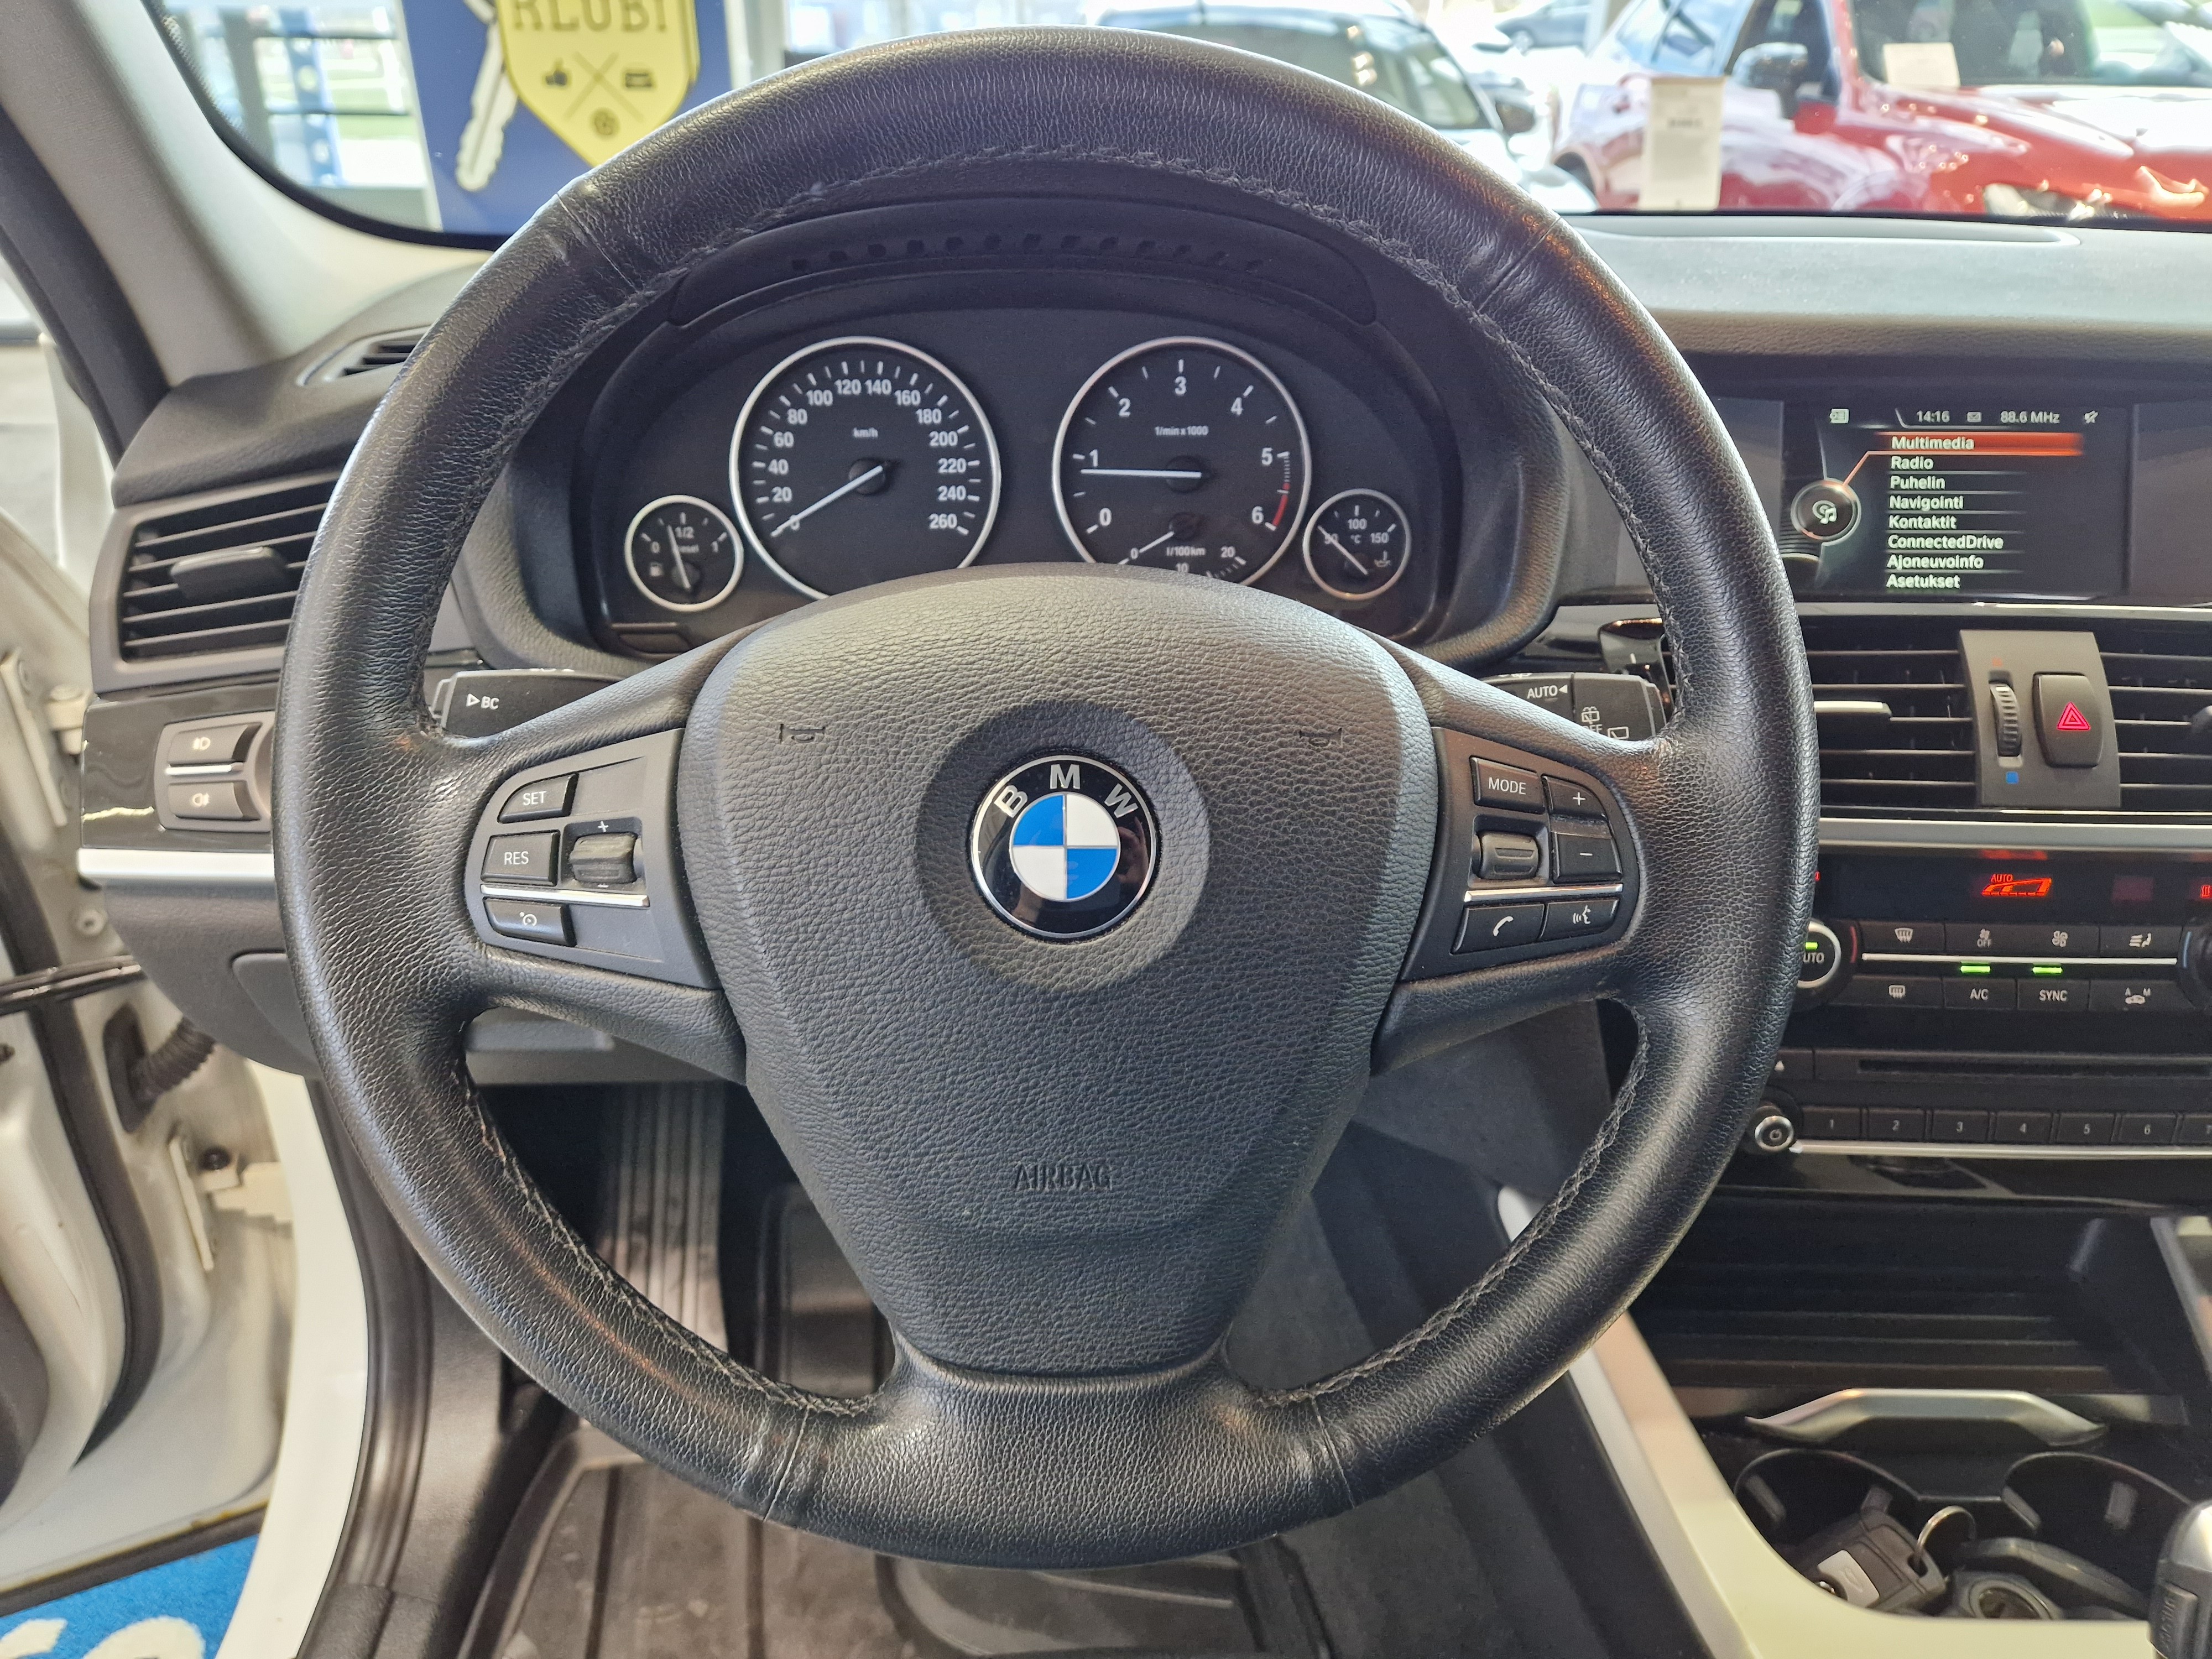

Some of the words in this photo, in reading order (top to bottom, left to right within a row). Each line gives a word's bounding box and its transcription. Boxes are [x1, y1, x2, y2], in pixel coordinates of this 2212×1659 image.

[834, 379, 861, 394] 120
[865, 379, 891, 395] 140
[1175, 377, 1186, 395] 3
[806, 390, 833, 405] 100
[894, 391, 920, 405] 160
[1119, 398, 1130, 417] 2
[1231, 397, 1243, 415] 4
[787, 409, 807, 425] 80
[916, 409, 941, 424] 180
[1916, 410, 1950, 422] 14:16
[2000, 411, 2028, 423] 88.6
[2031, 411, 2060, 424] MHz
[774, 432, 794, 447] 60
[853, 427, 878, 439] km/h
[930, 431, 958, 446] 200
[1891, 436, 1975, 451] Multimedia
[1089, 450, 1098, 467] 1
[1261, 448, 1272, 466] 5
[1891, 456, 1934, 471] Radio
[768, 459, 789, 474] 40
[938, 458, 966, 473] 220
[1890, 476, 1945, 490] Puhelin
[771, 487, 792, 502] 20
[938, 485, 966, 500] 240
[1890, 495, 1964, 512] Navigointi
[929, 514, 957, 529] 260
[1099, 508, 1112, 526] 0
[1252, 507, 1263, 524] 6
[1889, 515, 1957, 530] Kontaktit
[1348, 518, 1368, 530] 100
[1370, 532, 1390, 544] 150
[1887, 534, 2004, 550] ConnectedDrive
[651, 541, 660, 553] 0
[712, 541, 718, 552] 1
[1130, 547, 1139, 559] 0
[1221, 546, 1235, 558] 20
[1176, 562, 1188, 573] 10
[1887, 554, 1984, 570] Ajoneuvoinfo
[1886, 574, 1960, 589] Asetukset
[1527, 685, 1558, 699] AUTO
[481, 696, 499, 709] BC
[994, 764, 1138, 818] BMW
[1488, 777, 1526, 795] MODE
[523, 791, 546, 806] SET
[504, 852, 529, 865] RES
[1991, 874, 2013, 883] AUTO
[1977, 938, 1991, 948] OFF
[1803, 952, 1825, 963] UTO
[1970, 988, 1989, 1000] A/C
[2039, 989, 2068, 1001] SYNC
[1829, 1119, 1834, 1129] 1
[1892, 1120, 1900, 1131] 2
[1956, 1121, 1963, 1133] 3
[2020, 1123, 2027, 1133] 4
[2145, 1124, 2151, 1135] 6
[1015, 1161, 1112, 1190] AIRBAG
